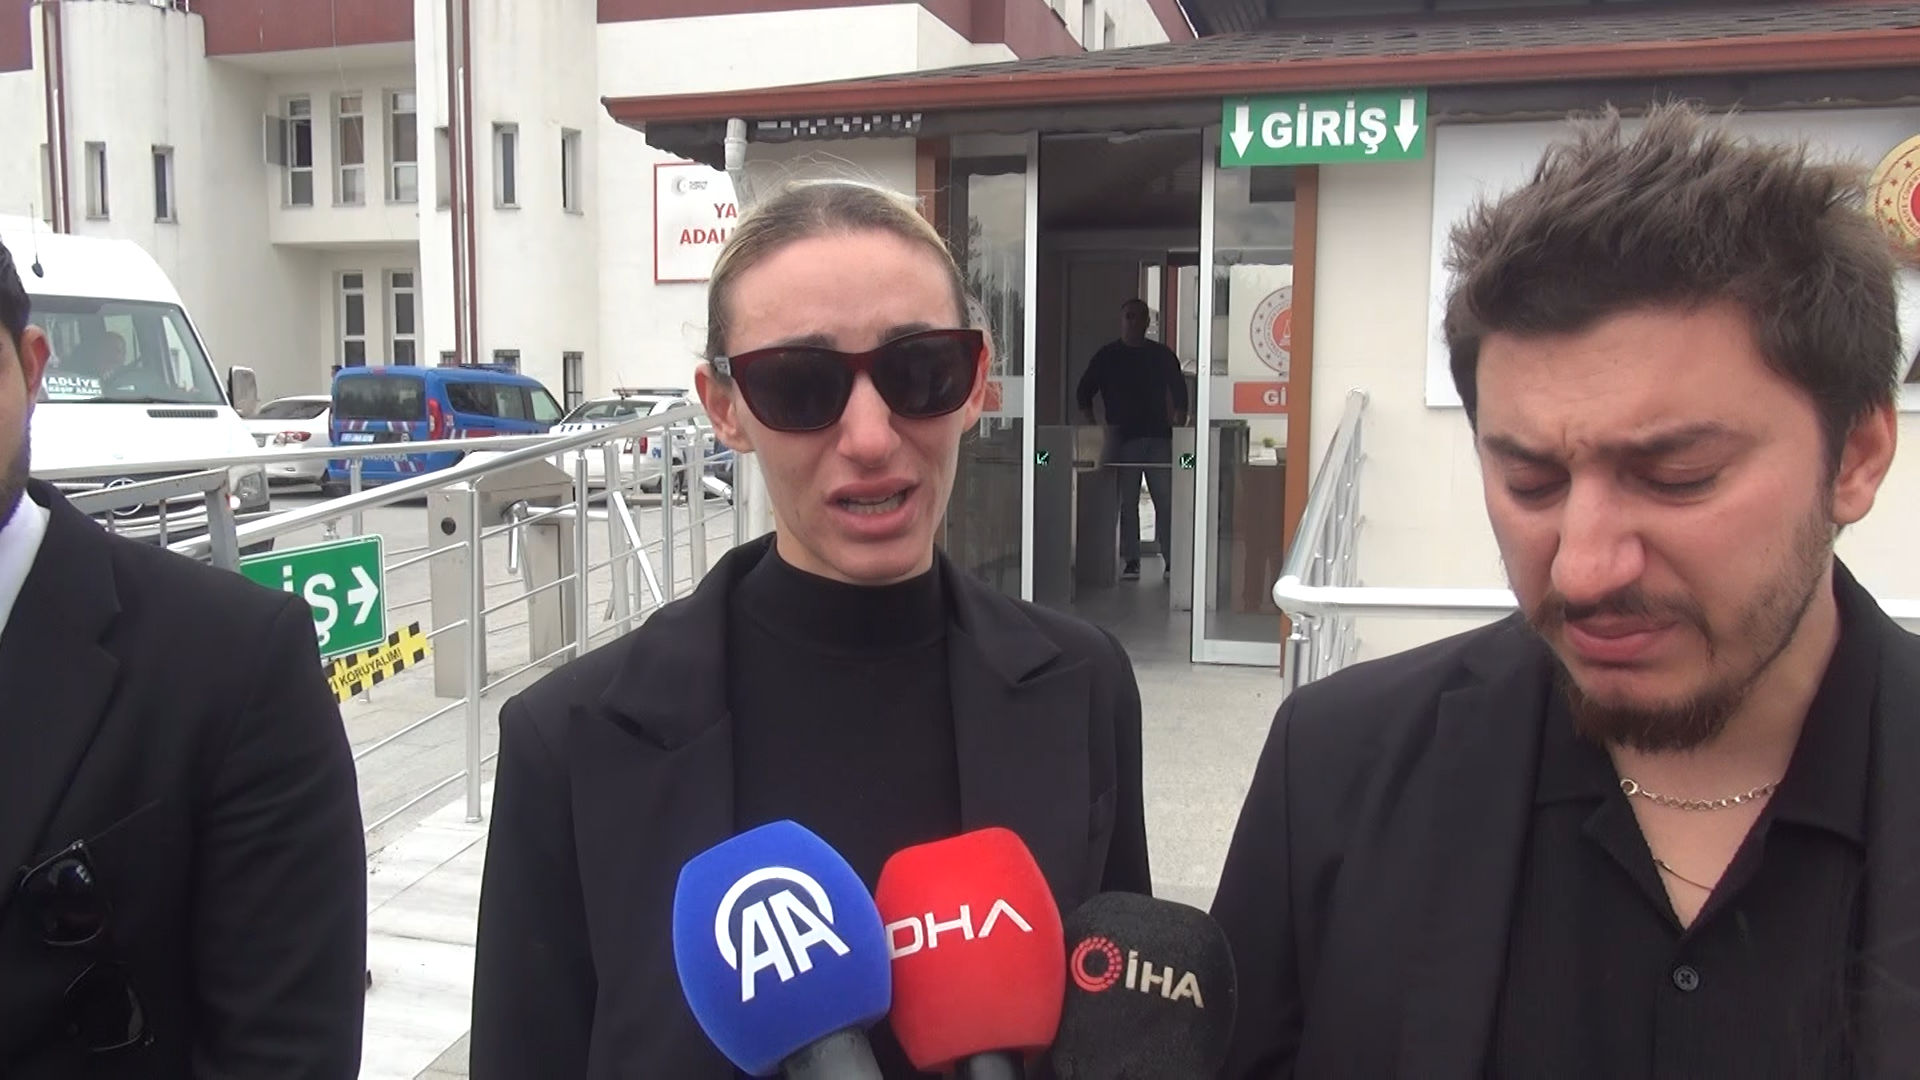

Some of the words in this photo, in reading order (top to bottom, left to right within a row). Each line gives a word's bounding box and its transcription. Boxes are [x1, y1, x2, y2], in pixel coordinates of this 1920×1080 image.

[1261, 100, 1387, 154] GİRİŞ
[714, 203, 737, 218] YA
[48, 376, 101, 388] ADLİYE
[1263, 386, 1287, 406] Gİ
[742, 889, 851, 1002] AA
[885, 898, 1033, 960] DHA
[1125, 950, 1204, 1009] İHA
